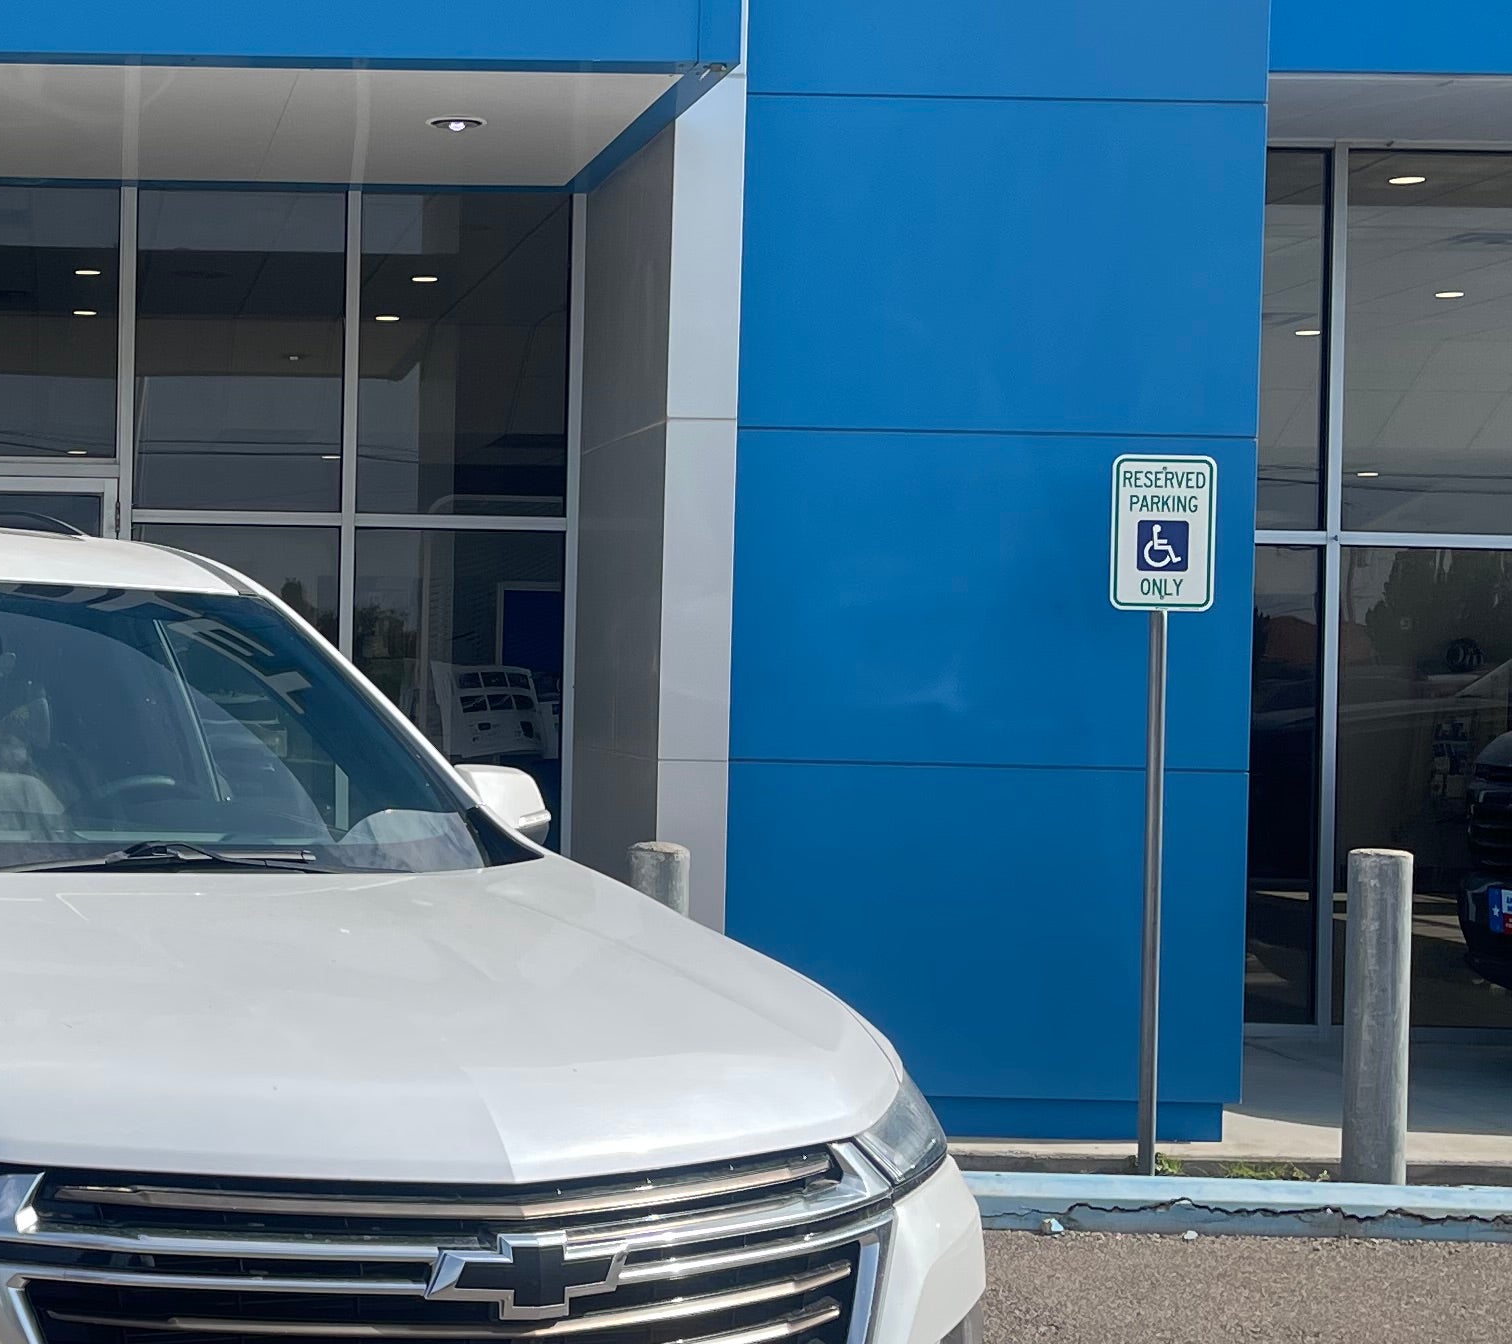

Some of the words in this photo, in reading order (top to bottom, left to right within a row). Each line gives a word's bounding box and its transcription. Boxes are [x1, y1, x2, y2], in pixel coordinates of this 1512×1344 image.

[1123, 471, 1206, 488] RESERVED
[1129, 495, 1198, 513] PARKING
[1140, 578, 1183, 596] ONLY
